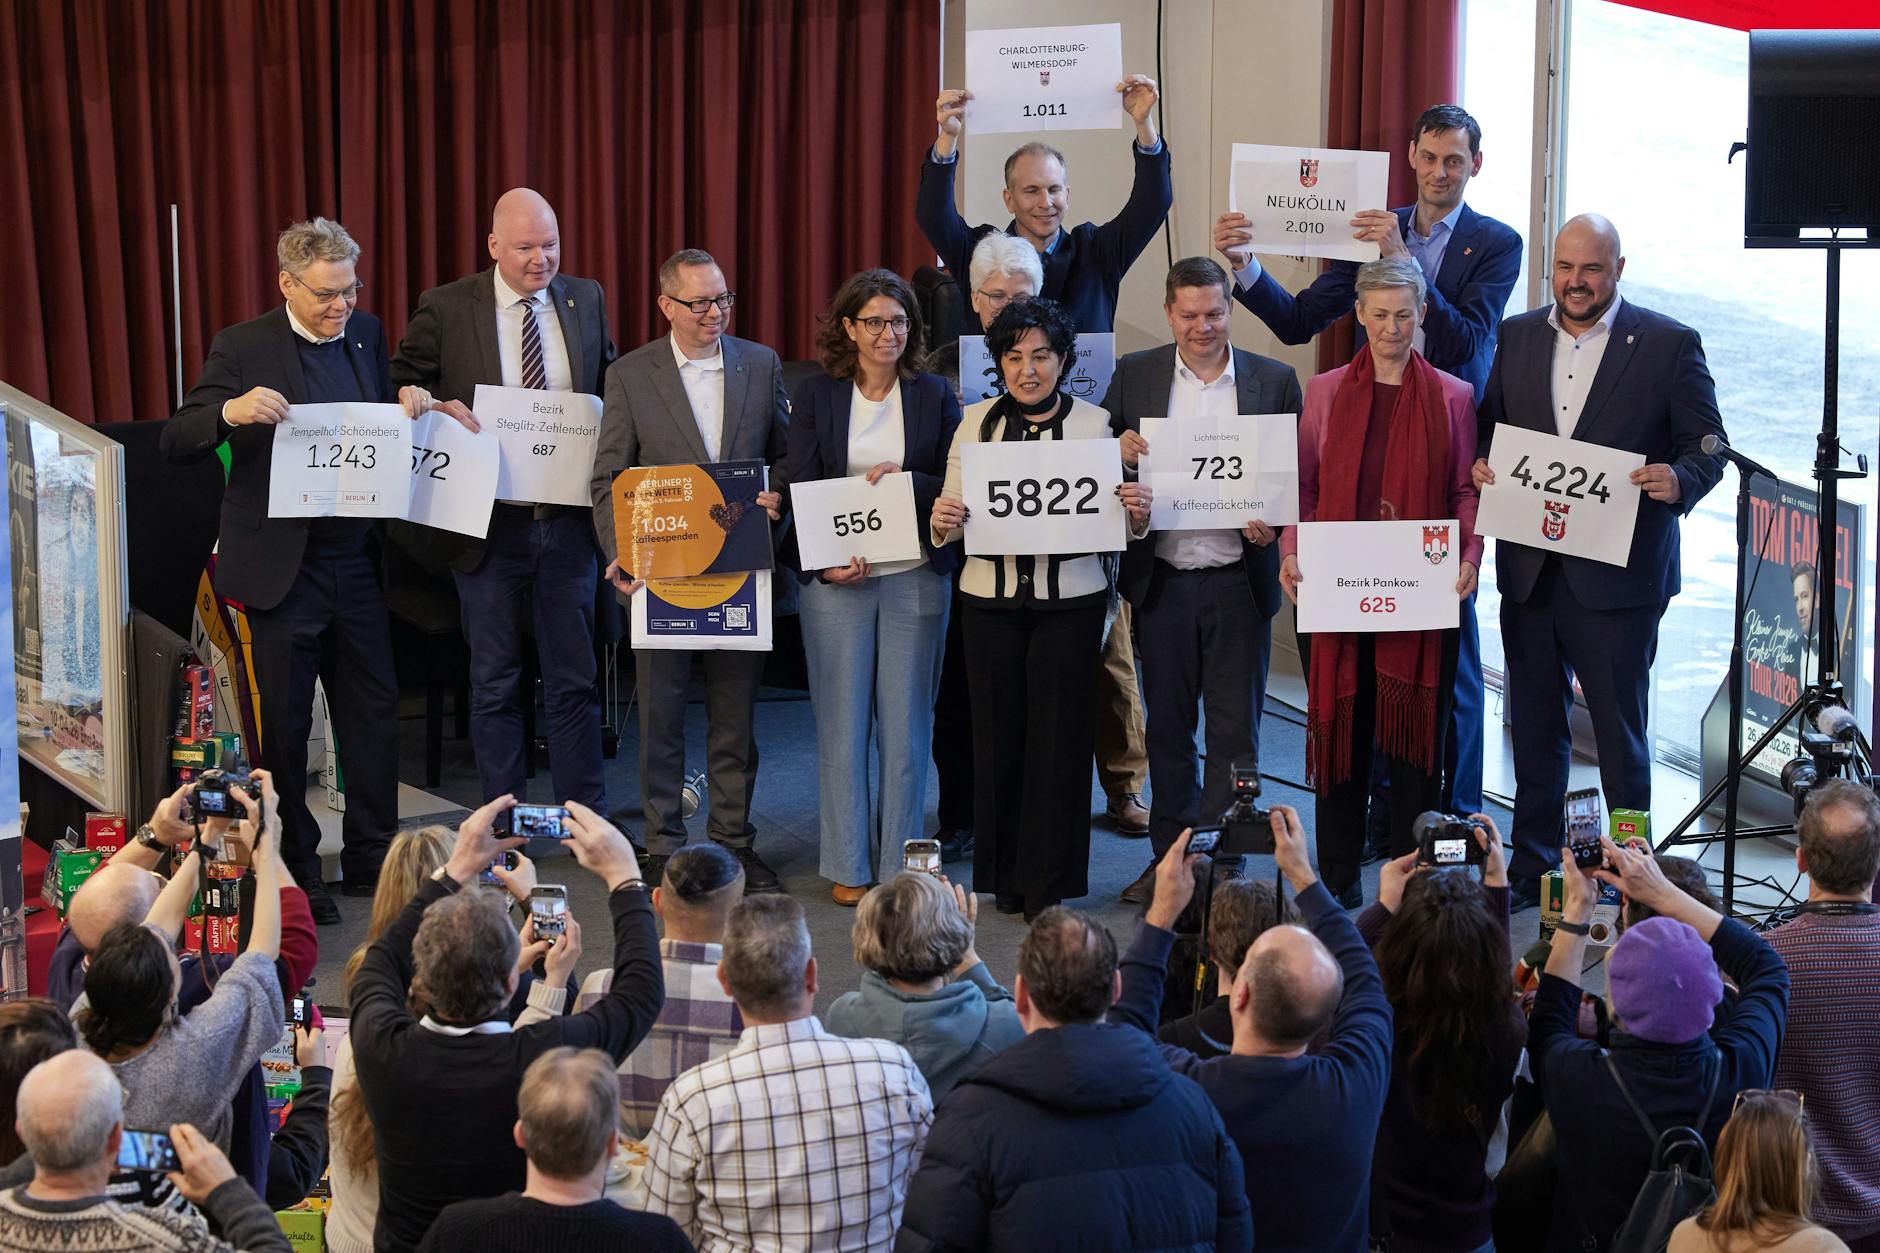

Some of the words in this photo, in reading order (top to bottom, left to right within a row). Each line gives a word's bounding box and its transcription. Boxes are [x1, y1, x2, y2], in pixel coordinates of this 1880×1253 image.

[999, 43, 1090, 56] CHARLOTTENBURG-
[1011, 58, 1078, 69] WILMERSDORF
[1023, 103, 1067, 117] 1.011
[1267, 194, 1346, 212] NEUKÖLLN
[1285, 220, 1324, 234] 2.010
[532, 401, 565, 415] Bezirk
[290, 425, 399, 440] Tempelhof-Schöneberg
[496, 417, 597, 437] Steglitz-Zehlendorf
[1194, 433, 1240, 442] Lichtenberg
[307, 444, 376, 469] 1.243
[532, 444, 557, 456] 687
[1191, 456, 1243, 480] 723
[1510, 455, 1611, 504] 4.224
[682, 477, 694, 502] 2026
[987, 476, 1100, 518] 5822
[1173, 499, 1264, 512] Kaffeepäckchen
[641, 515, 689, 534] 1.034
[833, 508, 883, 537] 556
[1750, 495, 1785, 566] TOM
[633, 532, 699, 545] Kaffeespenden
[1337, 577, 1371, 588] Bezirk
[1373, 577, 1419, 588] Pankow:
[1359, 596, 1396, 613] 625
[1750, 662, 1771, 699] TOUR
[1773, 672, 1799, 706] 2026
